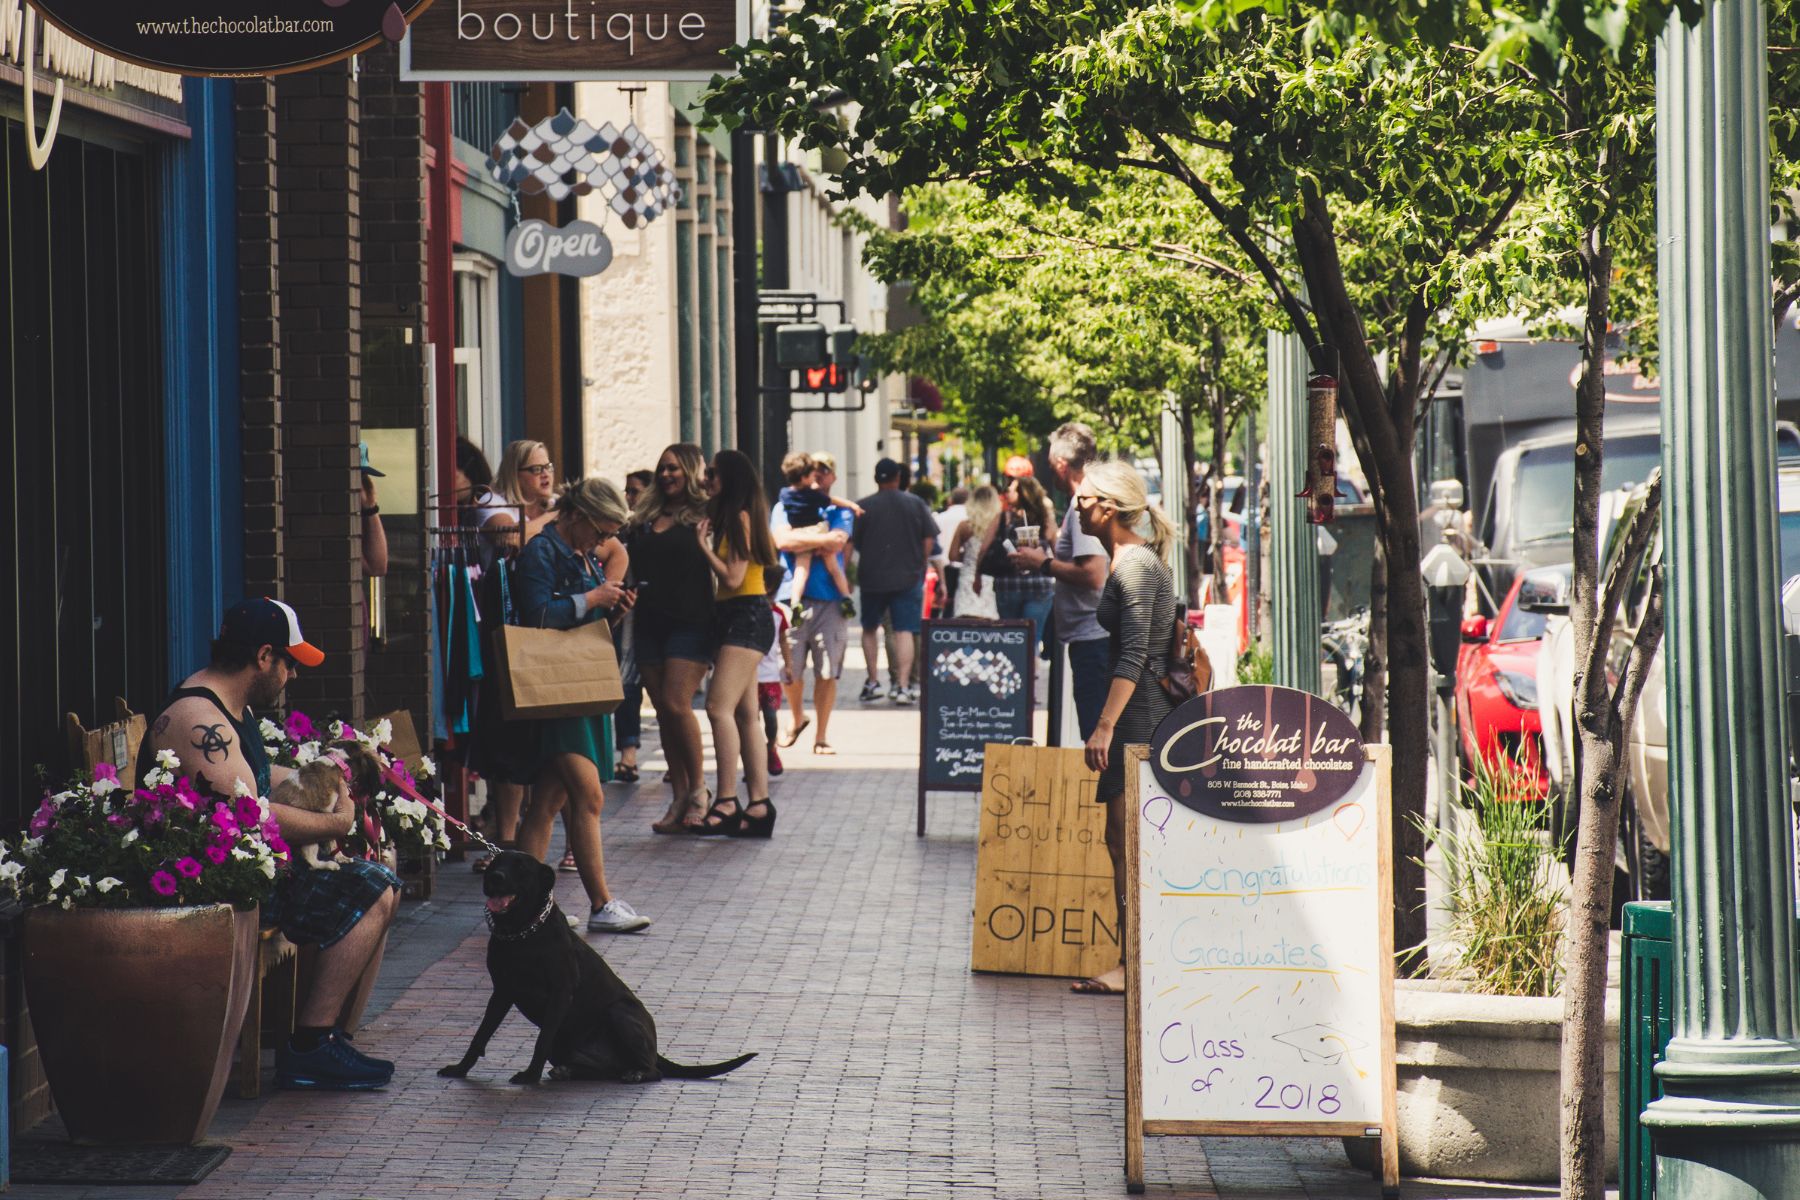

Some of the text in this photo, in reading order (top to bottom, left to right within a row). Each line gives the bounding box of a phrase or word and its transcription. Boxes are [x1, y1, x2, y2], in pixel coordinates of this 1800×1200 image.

[136, 15, 334, 35] www.thechocolatbar.com
[458, 0, 706, 57] boutique
[514, 222, 602, 272] Open
[1237, 712, 1263, 731] the
[1160, 716, 1356, 773] Chocolat bar
[1222, 757, 1353, 770] fine handcrafted chocolates
[987, 774, 1100, 821] SHIF
[1223, 780, 1231, 789] W
[988, 904, 1121, 947] OPEN
[1170, 916, 1328, 968] Graduates
[1159, 1022, 1245, 1063] Class
[1191, 1067, 1341, 1114] of 2018
